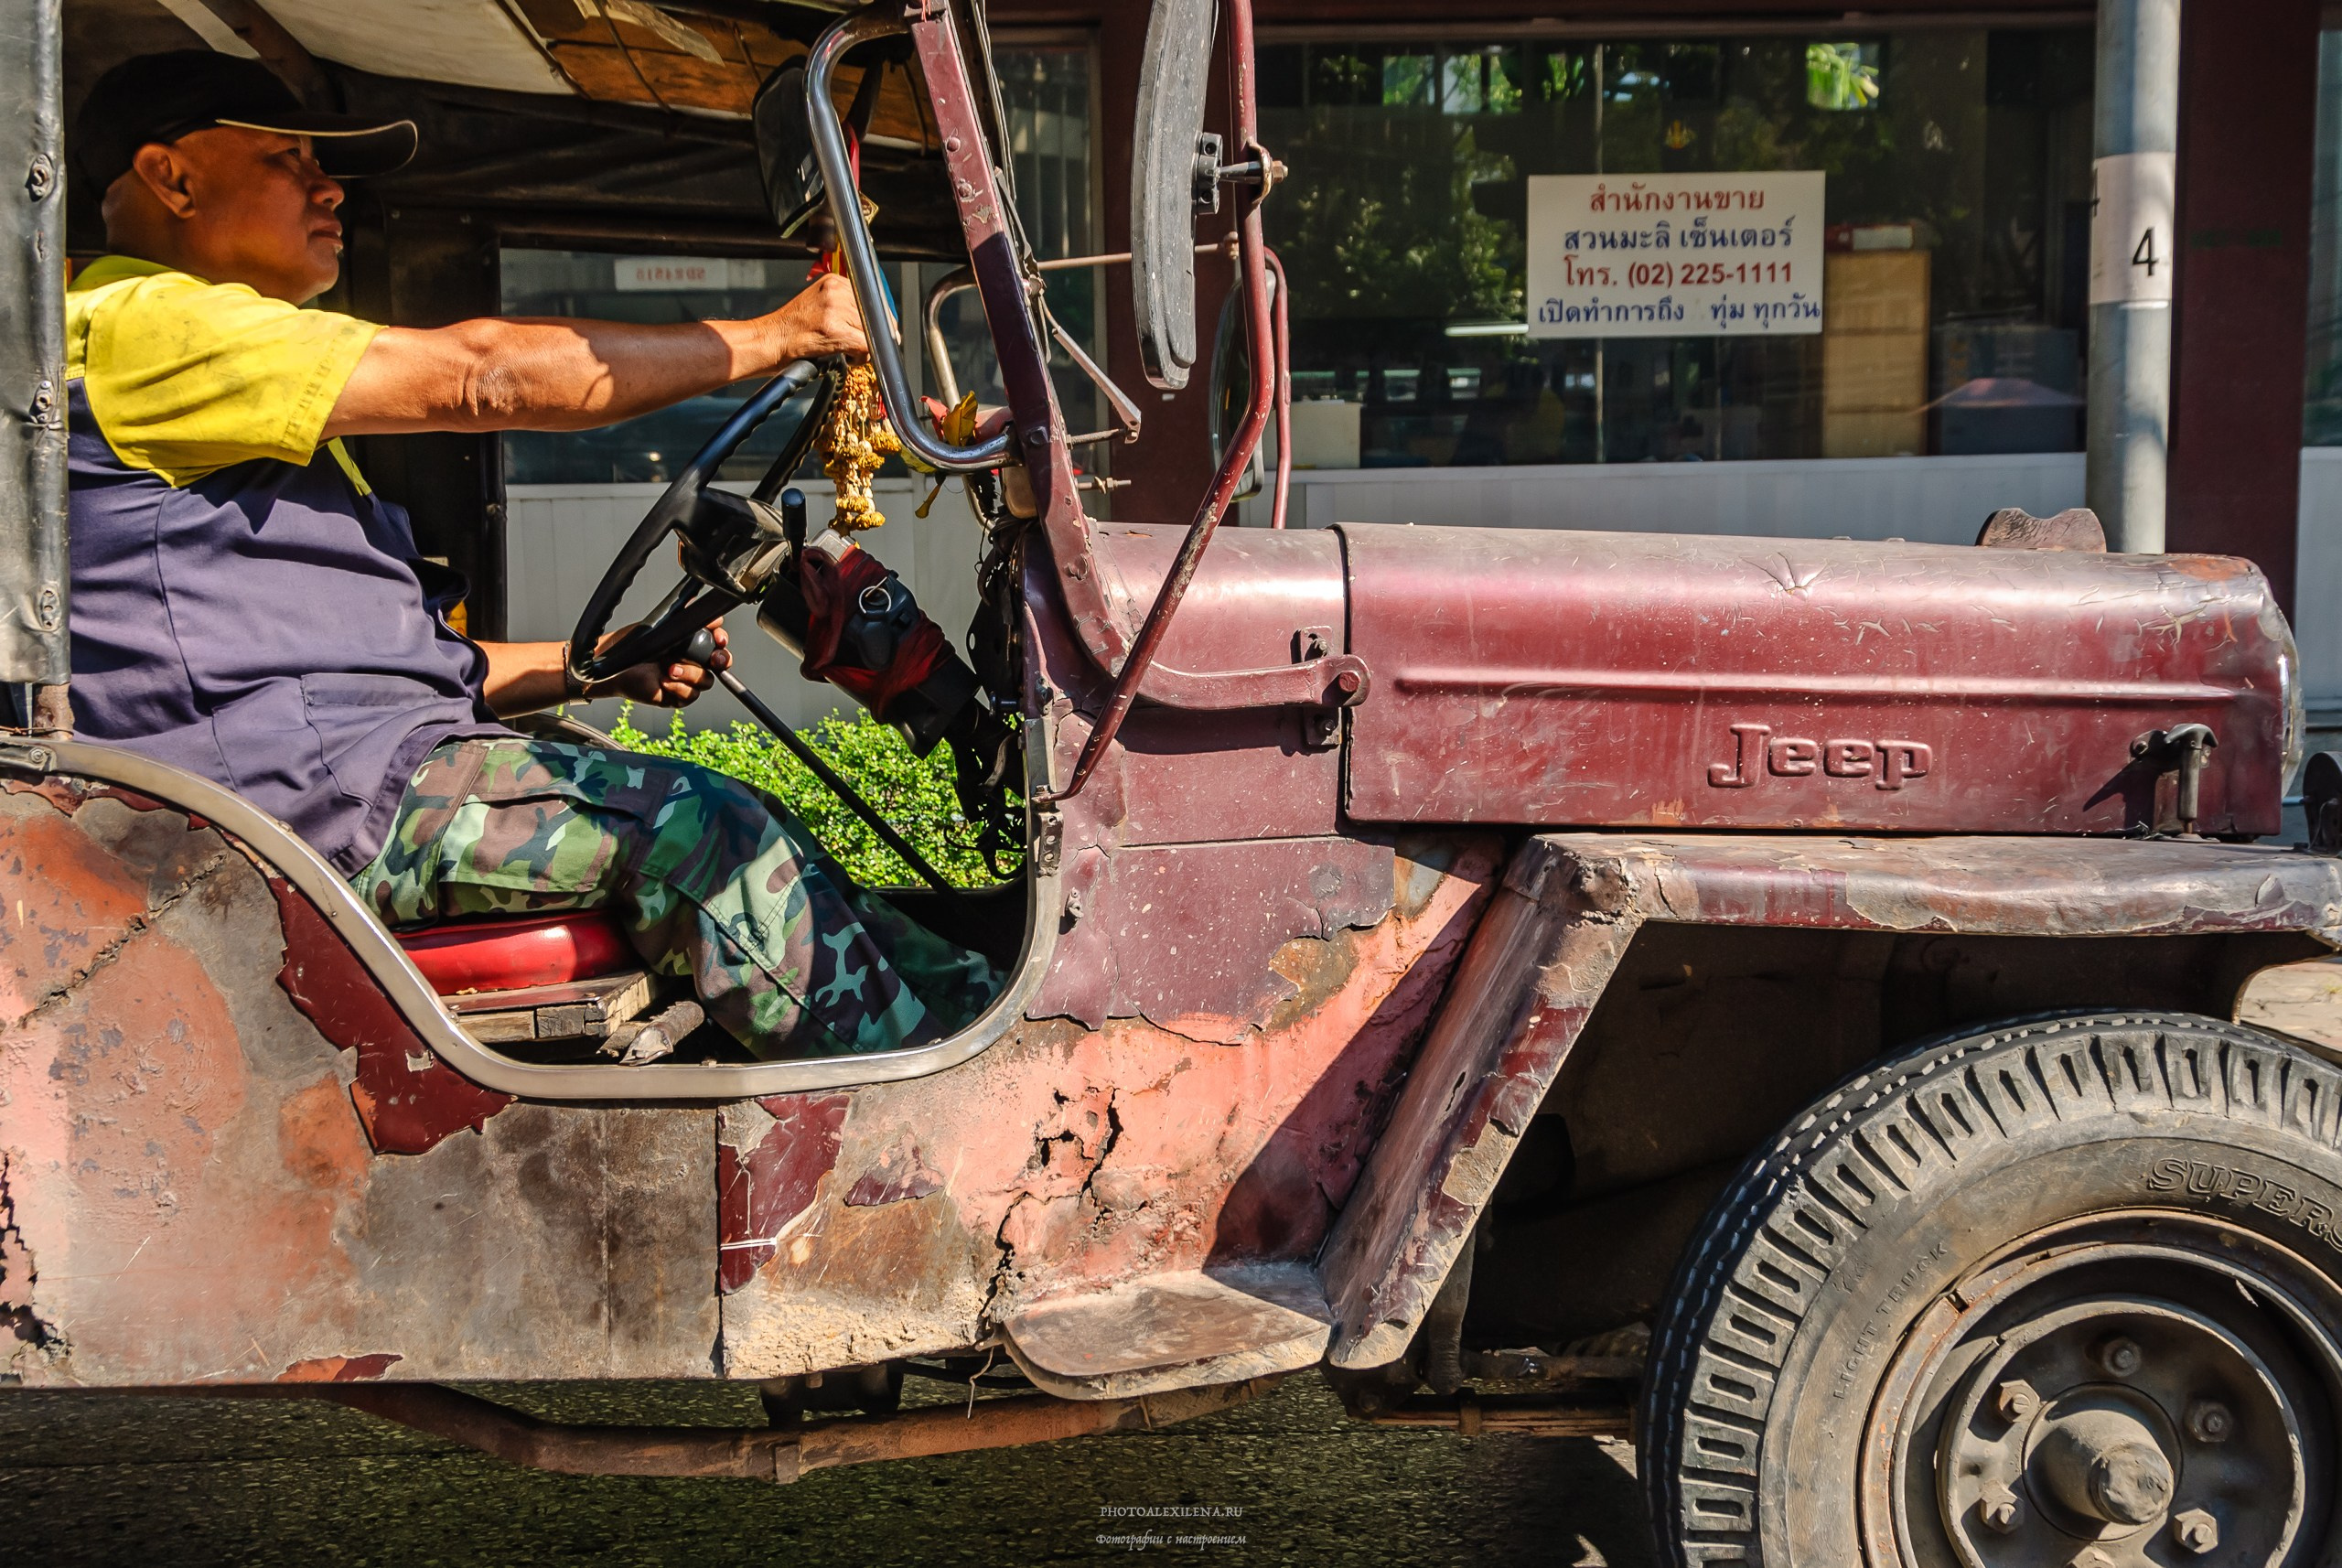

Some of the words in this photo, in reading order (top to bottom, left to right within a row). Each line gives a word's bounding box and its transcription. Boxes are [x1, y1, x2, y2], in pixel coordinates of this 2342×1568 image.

[1590, 182, 1766, 212] สำนักงานขาย
[1564, 220, 1671, 250] สวนมะลิ
[1681, 215, 1796, 249] เซ็นเตอร์
[2132, 226, 2159, 276] 4
[1563, 254, 1617, 286] โทร.
[1628, 261, 1673, 288] (02)
[1681, 261, 1792, 285] 225-1111
[1539, 295, 1684, 323] เปิดทำการถึง
[1711, 294, 1745, 329] ทุ่ม
[1753, 292, 1821, 329] ทุกวัน
[1707, 724, 1932, 790] Jeep
[1832, 1319, 1878, 1401] LIGHT
[1875, 1240, 1948, 1316] TRUCK
